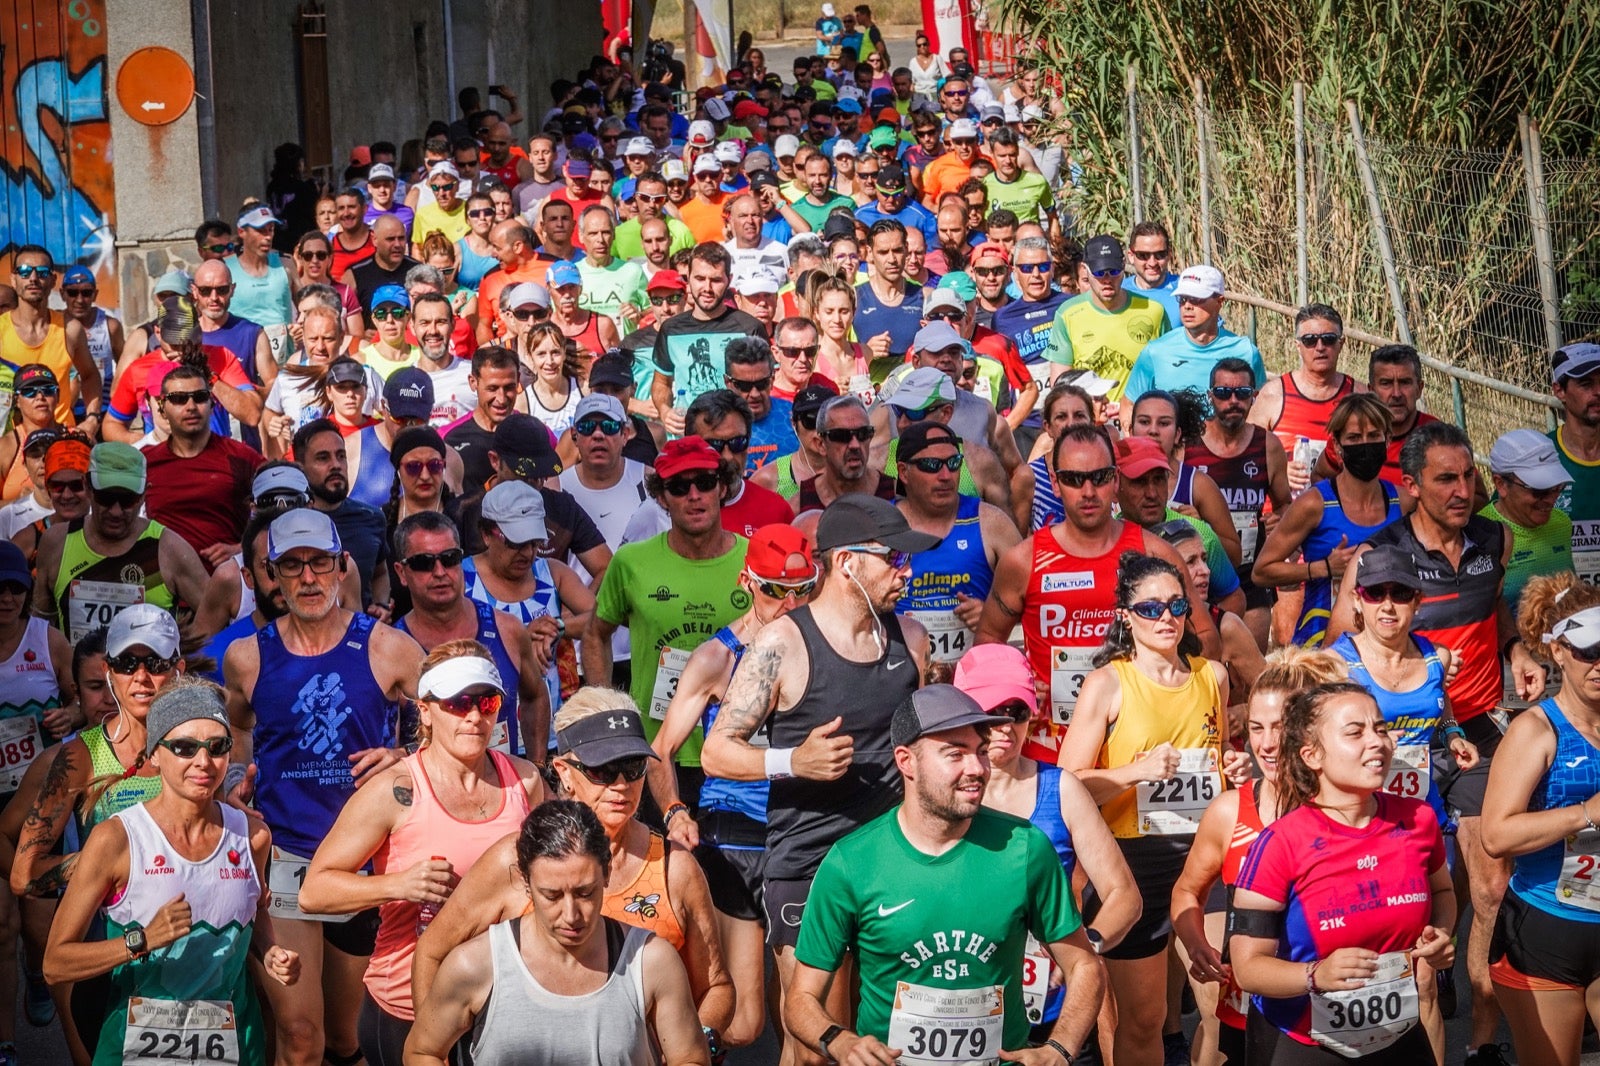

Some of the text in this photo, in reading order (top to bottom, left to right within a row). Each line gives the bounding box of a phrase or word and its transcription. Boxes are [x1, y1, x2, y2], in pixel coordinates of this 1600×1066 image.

[912, 572, 971, 588] olimpo
[912, 587, 950, 597] deportes
[1072, 608, 1116, 620] Clínicas
[683, 622, 697, 634] DE
[699, 622, 713, 634] LA
[281, 768, 320, 779] ANDRÉS
[319, 776, 354, 785] PRIETO
[1149, 775, 1214, 803] 2215
[1388, 771, 1420, 796] 43
[144, 867, 175, 875] VIATOR
[1320, 916, 1346, 931] 21K
[900, 929, 998, 969] SARTHE
[1327, 991, 1402, 1029] 3080
[138, 1031, 225, 1060] 2216
[908, 1026, 987, 1057] 3079
